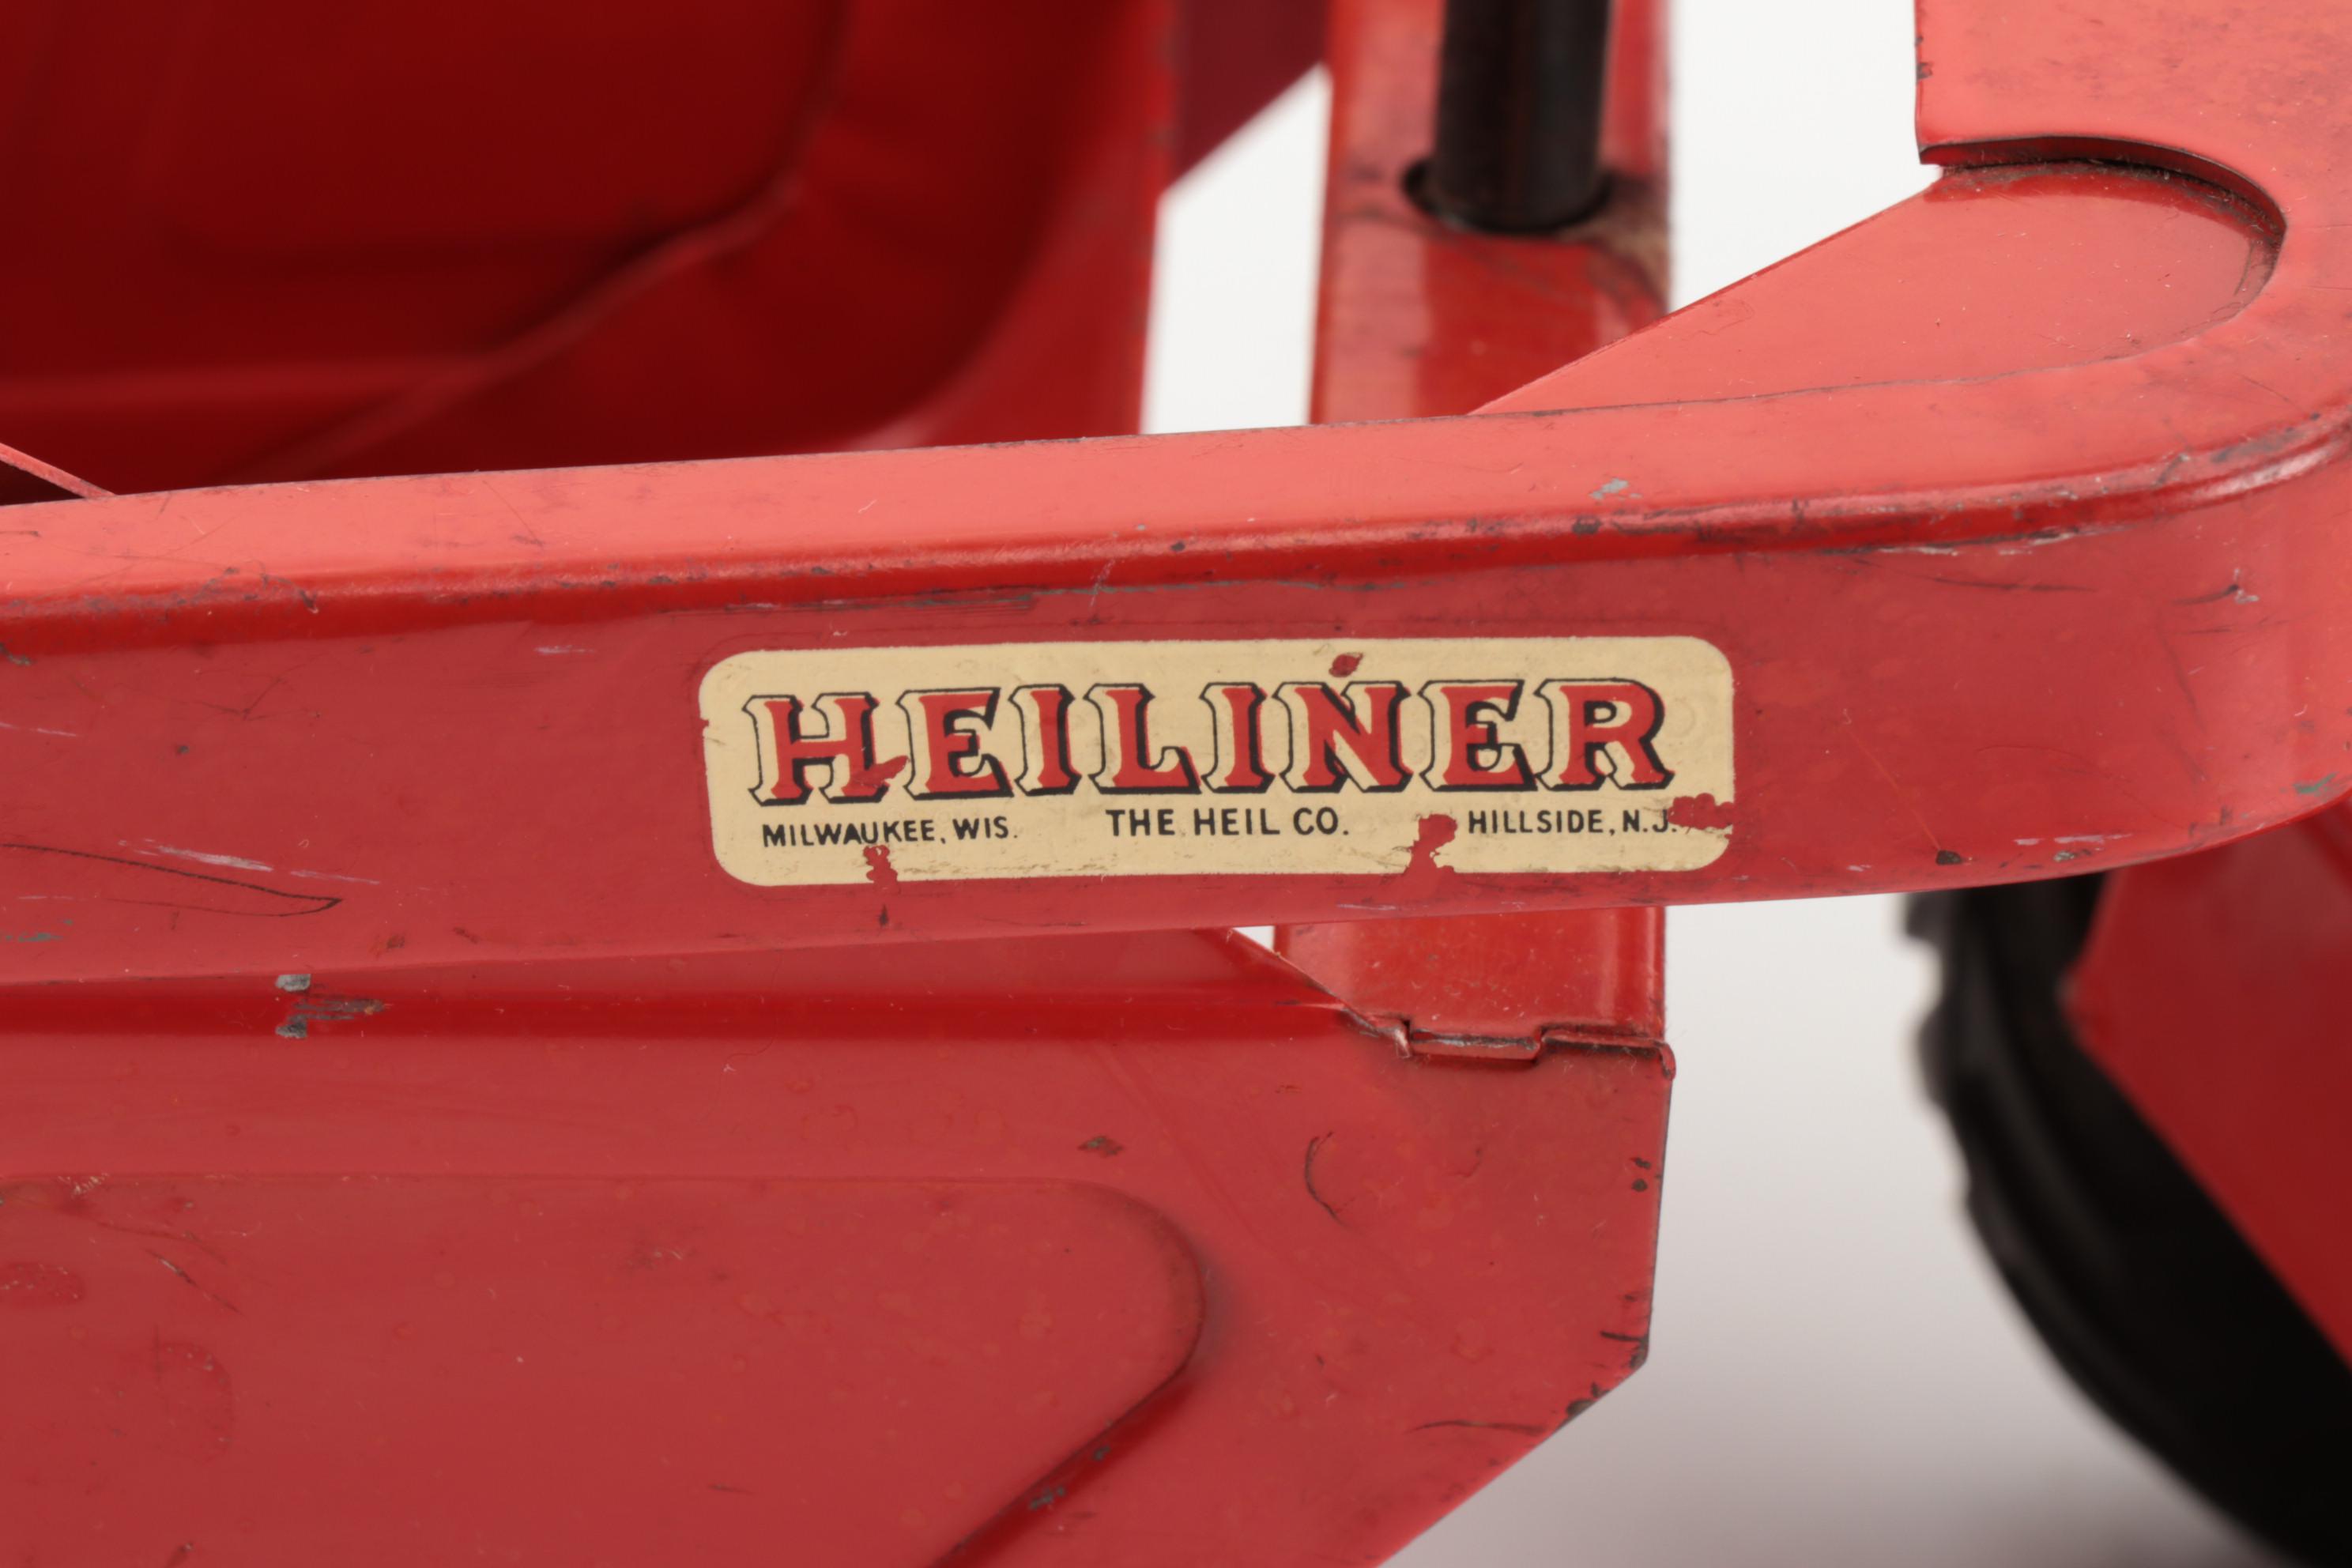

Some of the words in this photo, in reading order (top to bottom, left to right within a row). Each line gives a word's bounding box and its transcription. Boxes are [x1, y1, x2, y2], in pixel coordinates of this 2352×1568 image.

[742, 678, 1676, 806] HEILINER
[761, 819, 946, 847] MILWAUKEE,
[951, 816, 1018, 841] WIS.
[1106, 809, 1176, 838] THE
[1193, 808, 1280, 837] HEIL
[1292, 807, 1350, 835] CO.
[1468, 809, 1615, 835] HILLSIDE,
[1622, 808, 1678, 834] N.J.
